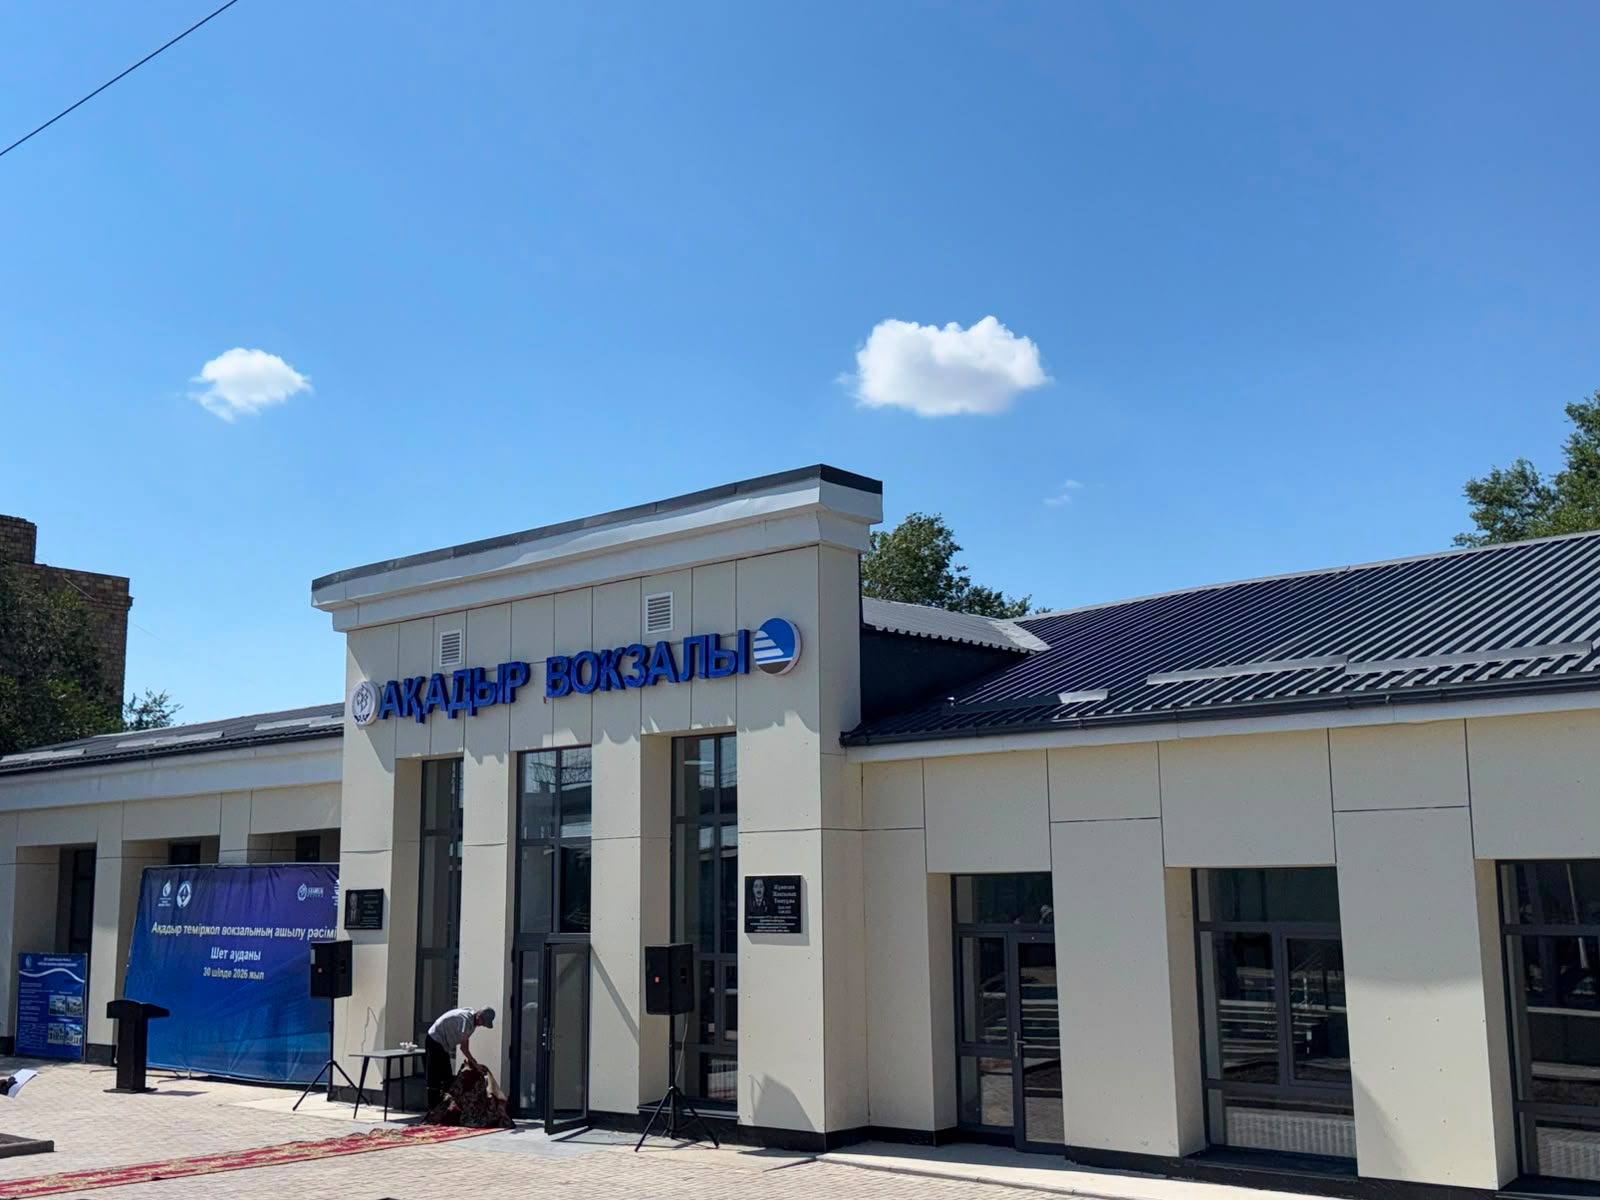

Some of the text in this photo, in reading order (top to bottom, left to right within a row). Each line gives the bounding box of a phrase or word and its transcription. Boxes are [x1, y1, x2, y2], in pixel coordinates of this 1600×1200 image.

[377, 629, 750, 724] АҚАДЫР ВОКЗАЛЫ
[221, 926, 273, 939] вокзалының
[274, 927, 306, 941] ашылу
[210, 947, 262, 963] Шет ауданы
[248, 971, 265, 980] жыл
